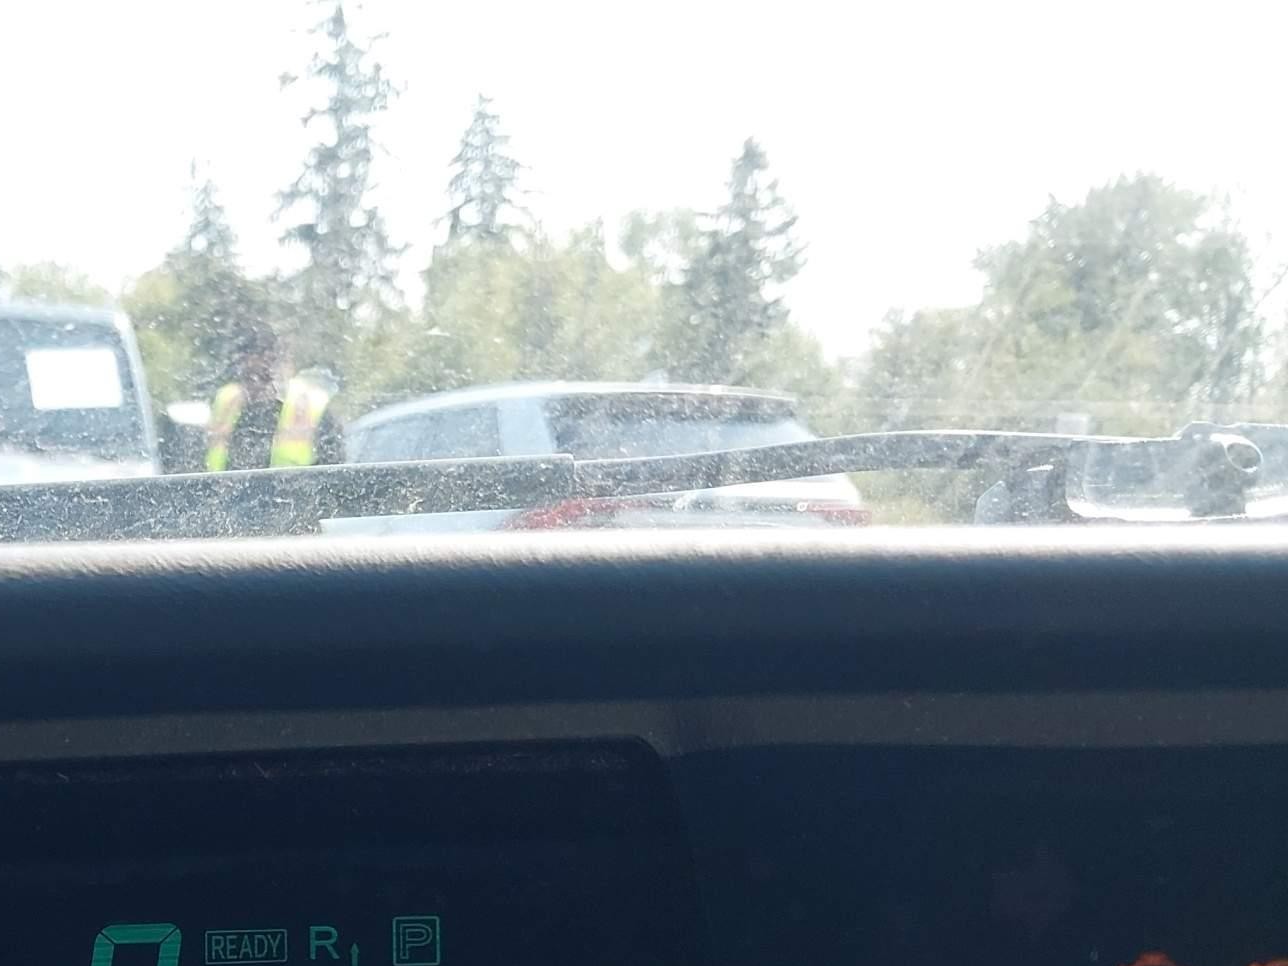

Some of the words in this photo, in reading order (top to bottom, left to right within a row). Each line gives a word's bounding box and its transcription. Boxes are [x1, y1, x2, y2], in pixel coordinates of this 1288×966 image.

[211, 934, 283, 961] READY
[309, 927, 339, 960] R
[401, 924, 433, 958] P
